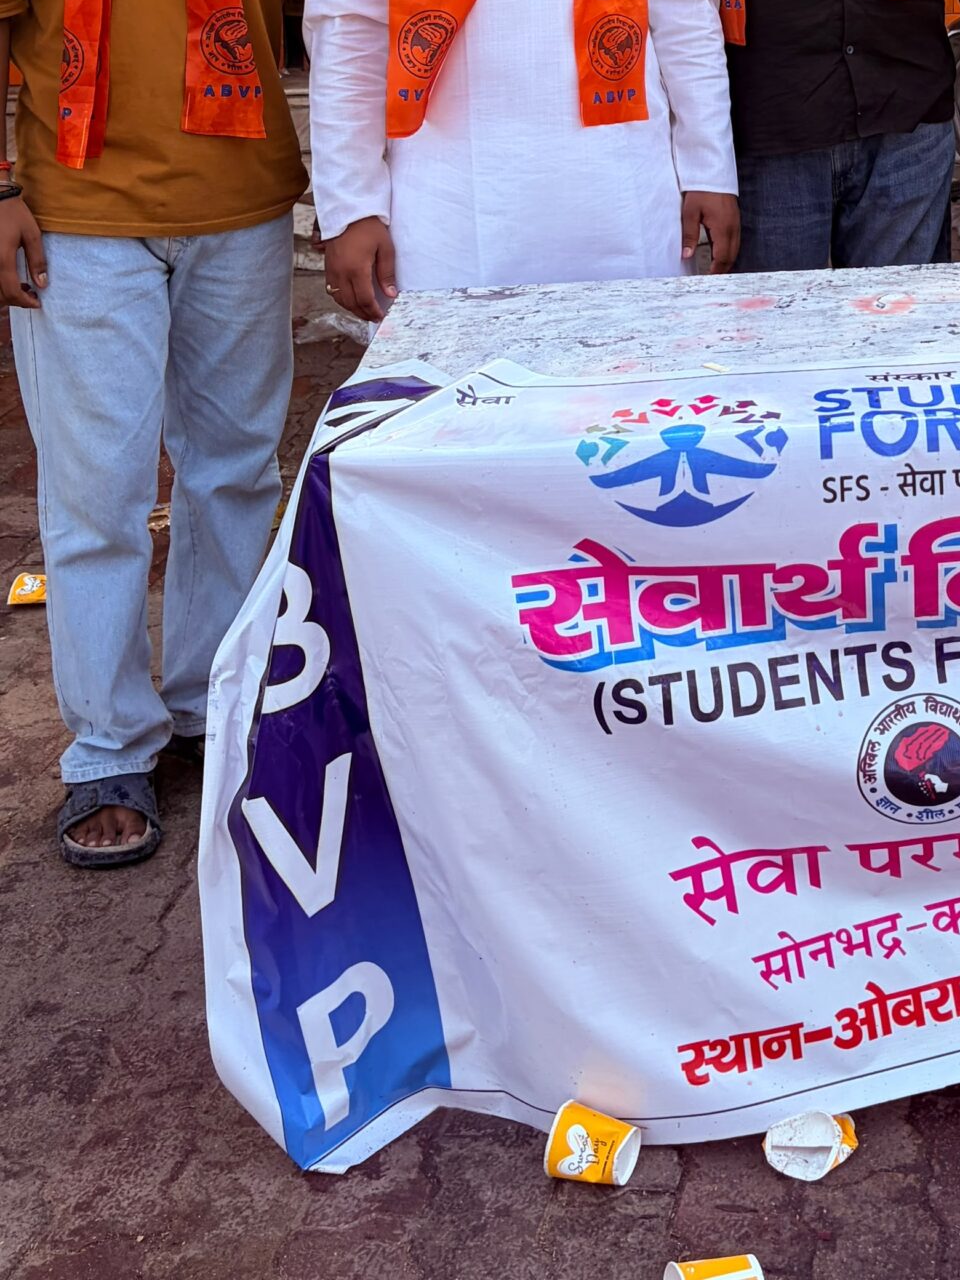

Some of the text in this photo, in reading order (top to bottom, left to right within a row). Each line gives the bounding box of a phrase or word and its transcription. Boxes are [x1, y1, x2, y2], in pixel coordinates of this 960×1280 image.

[593, 89, 636, 105] ABVP
[865, 371, 957, 383] संस्कार
[822, 475, 871, 503] SFS
[897, 463, 946, 497] सेवा
[511, 522, 881, 660] सेवार्थ
[593, 639, 915, 735] (STUDENTS
[873, 701, 917, 736] भारतीय
[669, 836, 829, 926] सेवा
